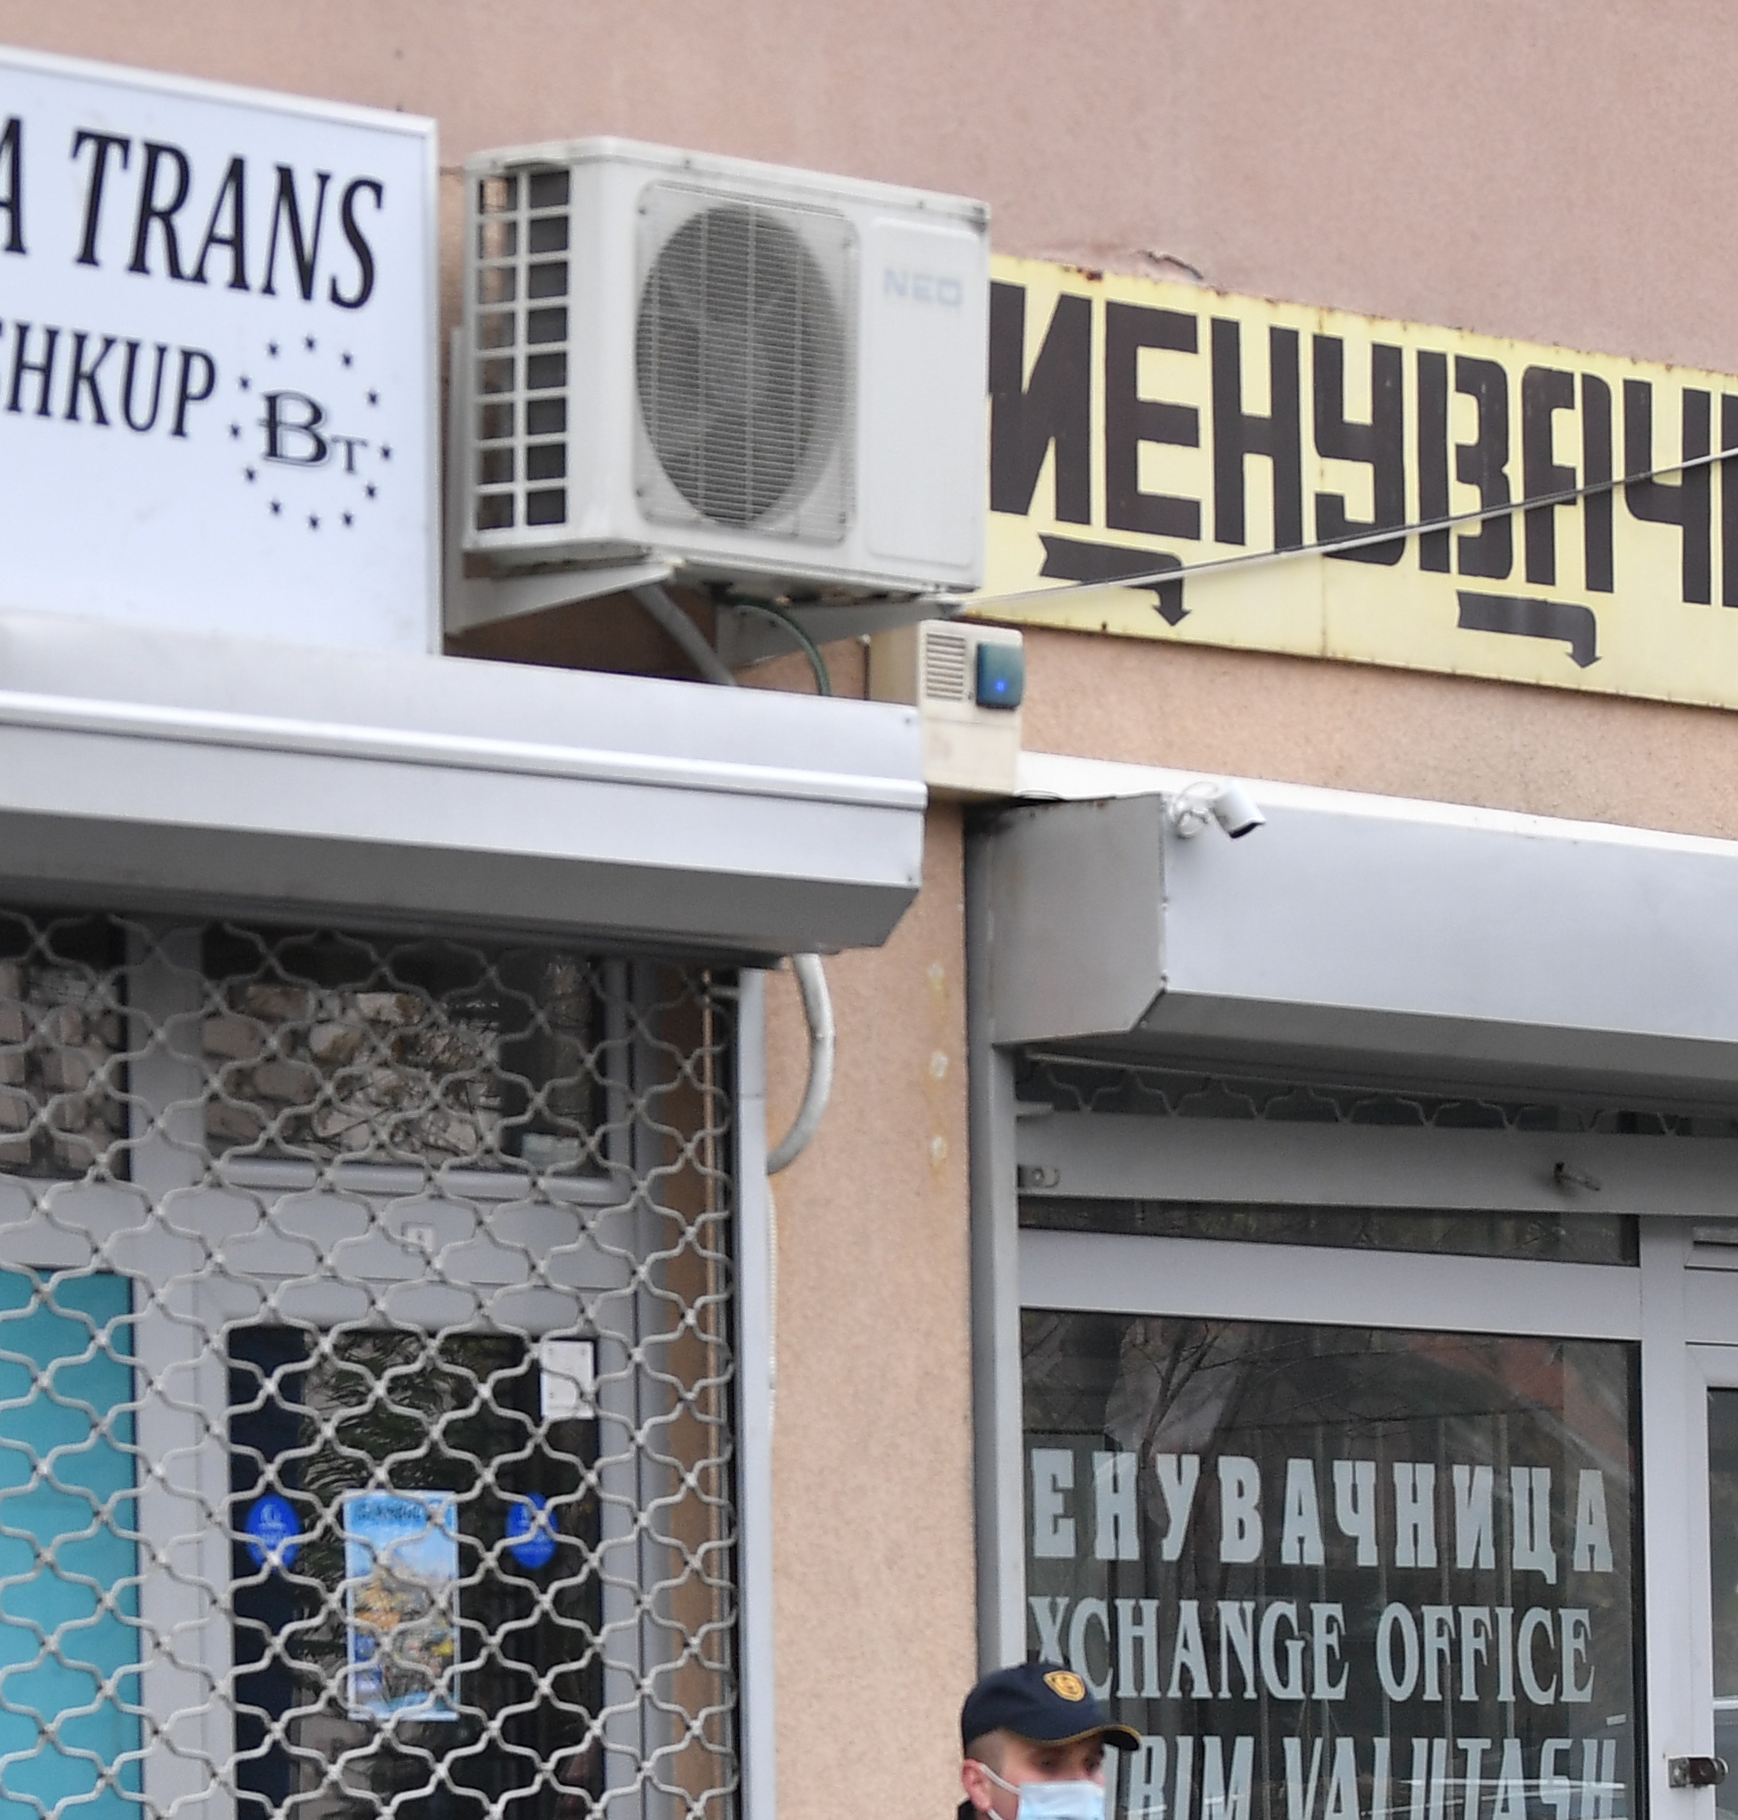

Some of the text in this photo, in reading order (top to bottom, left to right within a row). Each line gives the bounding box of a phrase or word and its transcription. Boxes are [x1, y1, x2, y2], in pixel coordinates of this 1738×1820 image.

[70, 126, 385, 311] TRANS
[883, 266, 965, 307] NEO
[1031, 1448, 1613, 1584] ЕНУВАЧНИЦА
[1028, 1596, 1595, 1704] XCHANGE OFFICE
